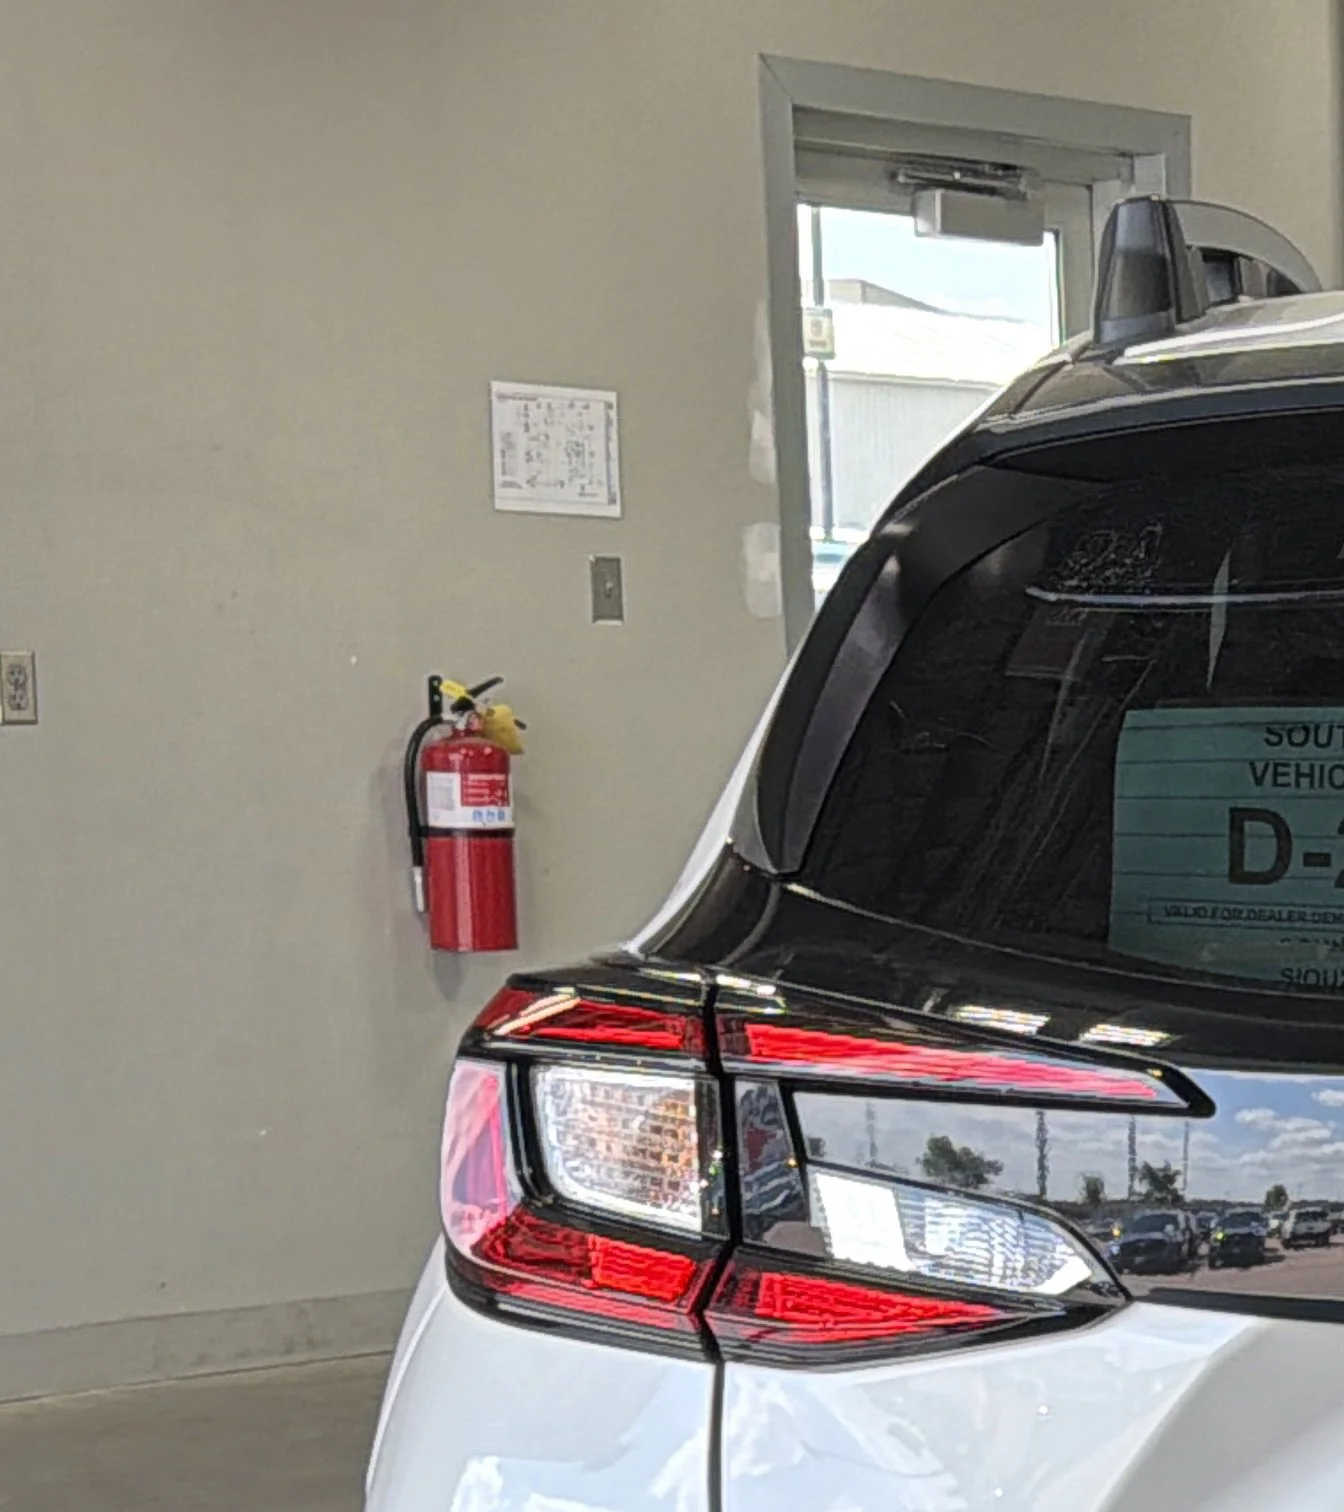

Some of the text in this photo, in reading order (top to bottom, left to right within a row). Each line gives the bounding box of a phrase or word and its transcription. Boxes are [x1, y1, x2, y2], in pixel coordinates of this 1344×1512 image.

[1164, 904, 1207, 919] VALID
[1211, 906, 1243, 921] FOR
[1247, 908, 1307, 925] DEALER
